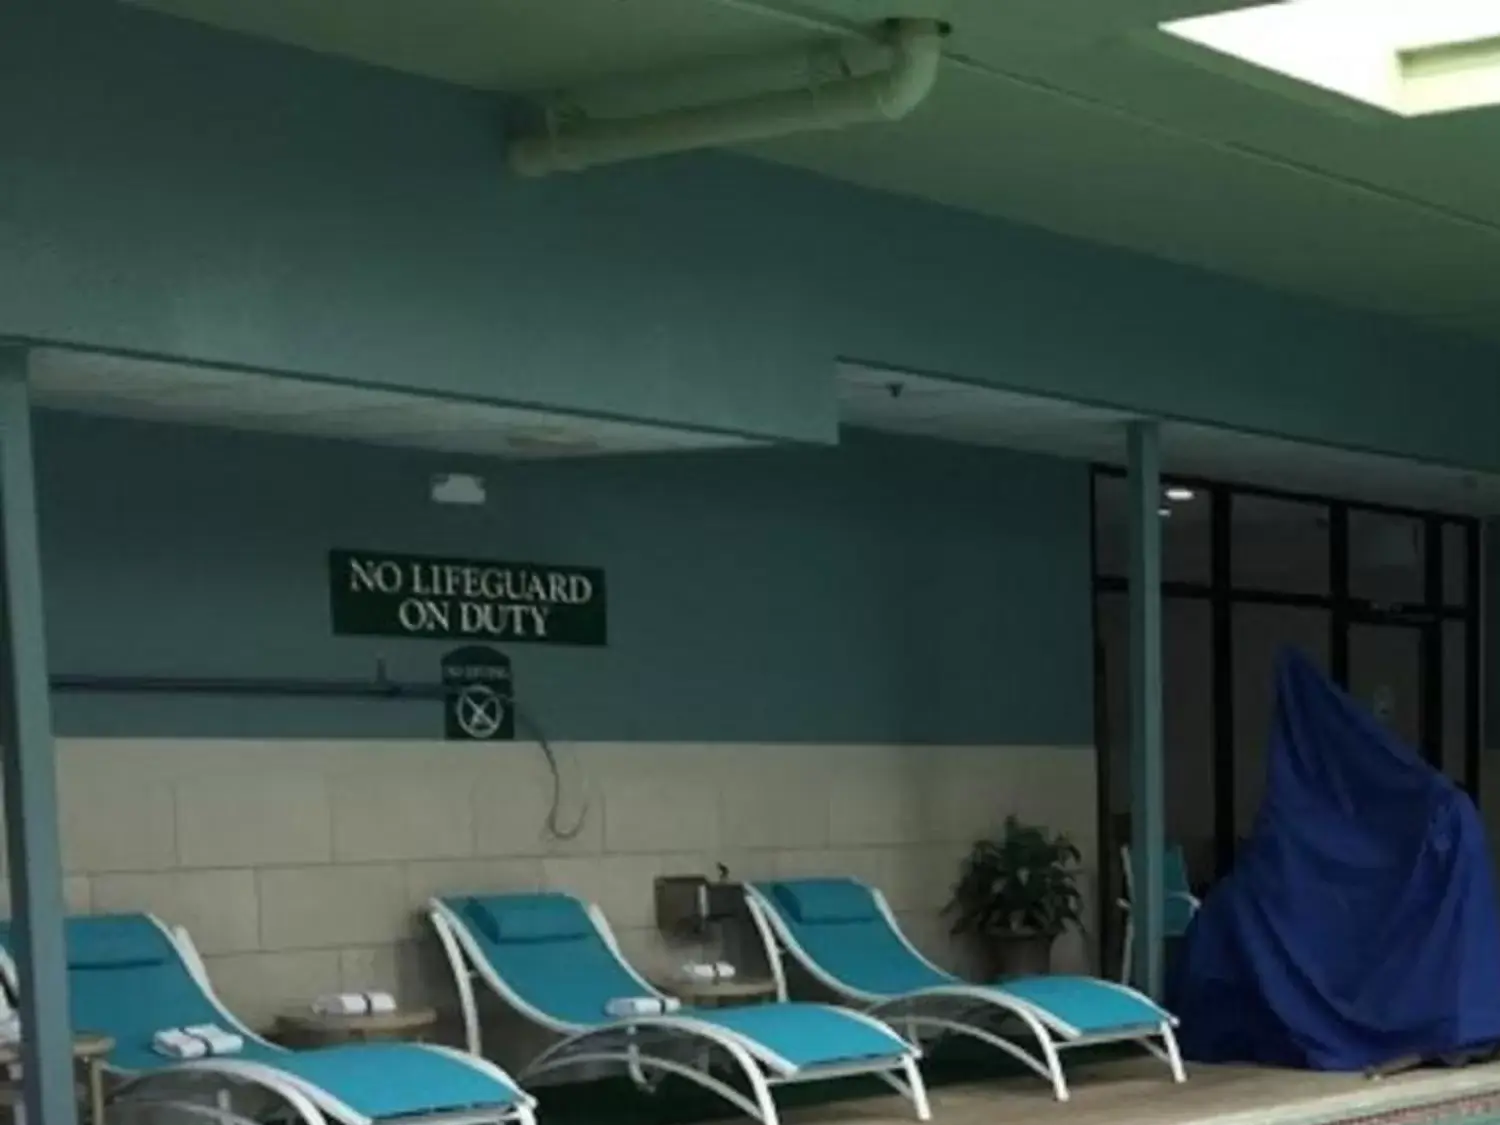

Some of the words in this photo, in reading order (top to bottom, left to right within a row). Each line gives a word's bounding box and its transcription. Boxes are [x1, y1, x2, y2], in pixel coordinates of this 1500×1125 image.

[351, 558, 402, 593] NO
[412, 564, 593, 605] LIFEGUARD
[399, 598, 450, 632] ON
[460, 602, 551, 636] DUTY
